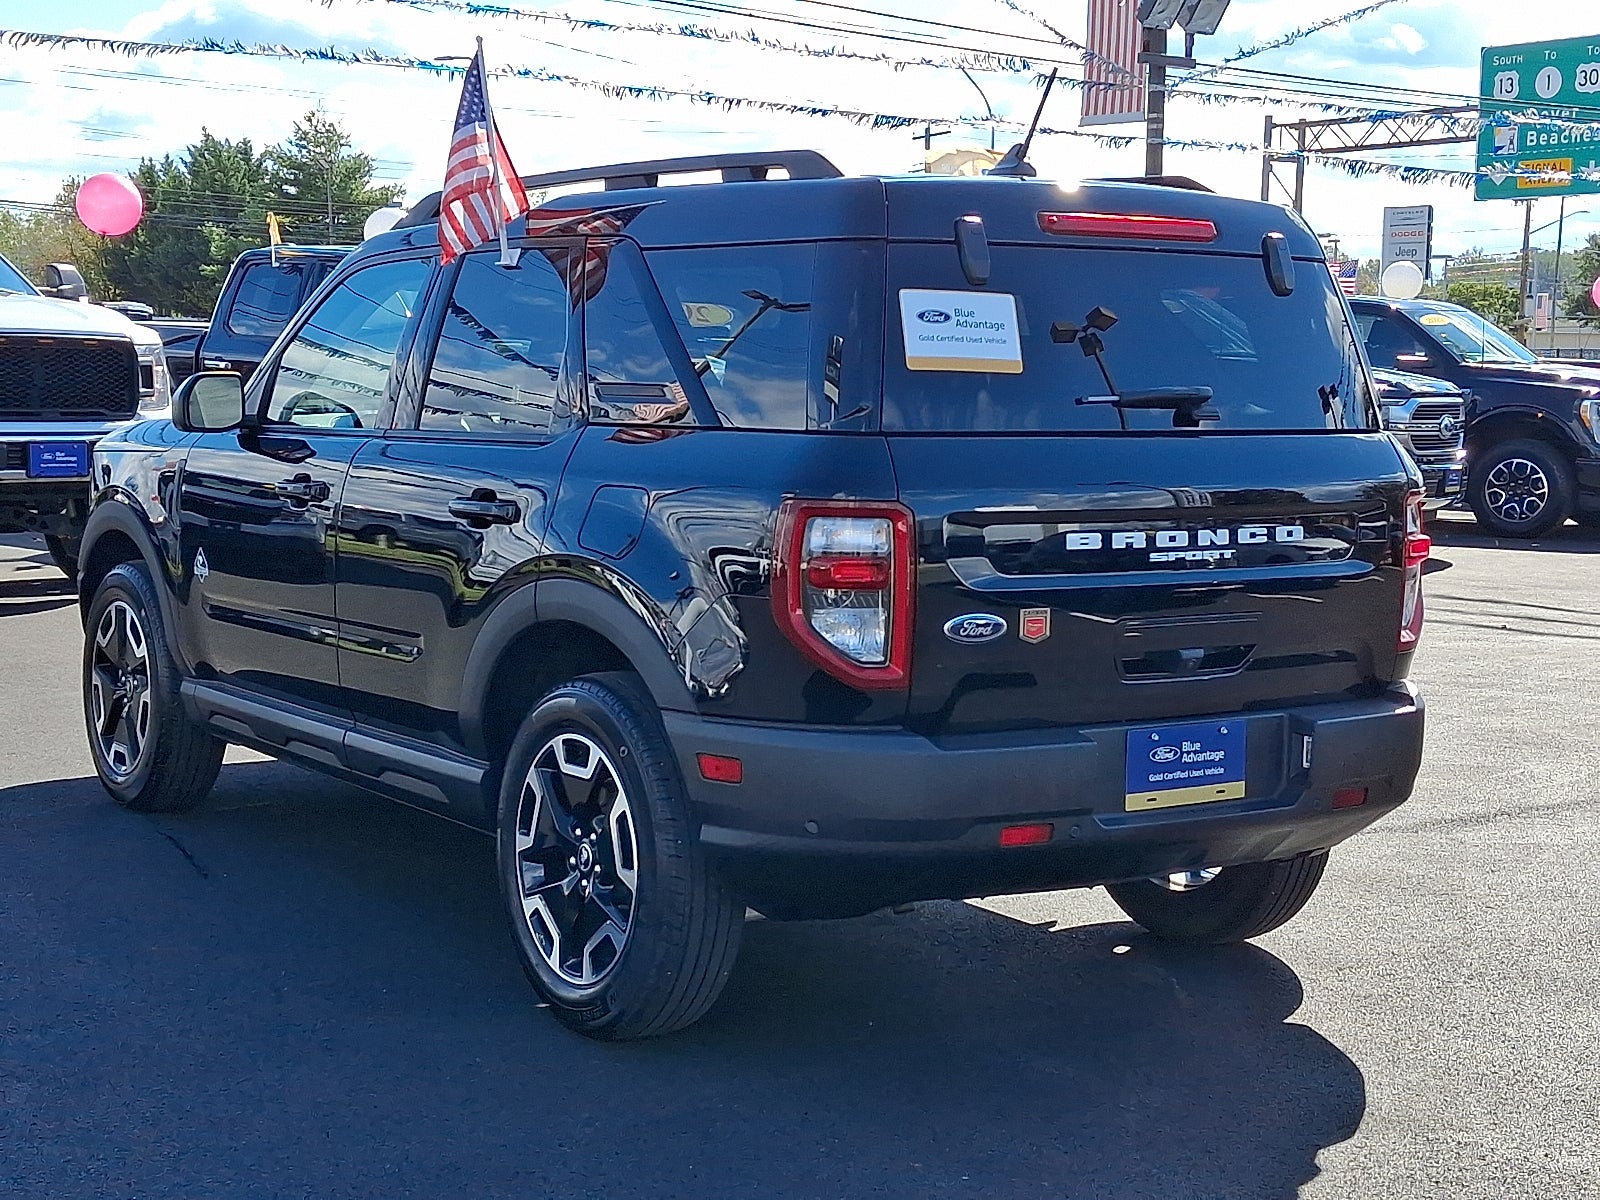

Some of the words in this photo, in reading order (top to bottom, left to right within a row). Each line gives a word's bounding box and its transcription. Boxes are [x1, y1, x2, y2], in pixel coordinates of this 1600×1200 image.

[1492, 55, 1523, 66] SOUTH
[1499, 77, 1514, 94] 13
[1546, 73, 1551, 91] 1
[1395, 246, 1418, 258] Jeep
[953, 307, 976, 318] Blue
[955, 318, 1006, 332] Advantage
[918, 334, 935, 342] Gold
[936, 334, 965, 343] Certified
[965, 336, 983, 344] Used
[983, 337, 1007, 345] Vehicle
[1065, 525, 1305, 551] BRONCO
[1149, 549, 1237, 562] SPORT
[1182, 740, 1201, 752] Blue
[1181, 751, 1225, 763] Advantage
[1148, 772, 1163, 782] Gold
[1164, 770, 1188, 780] Certified
[1189, 768, 1204, 778] Used
[1204, 766, 1225, 776] Vehicle
